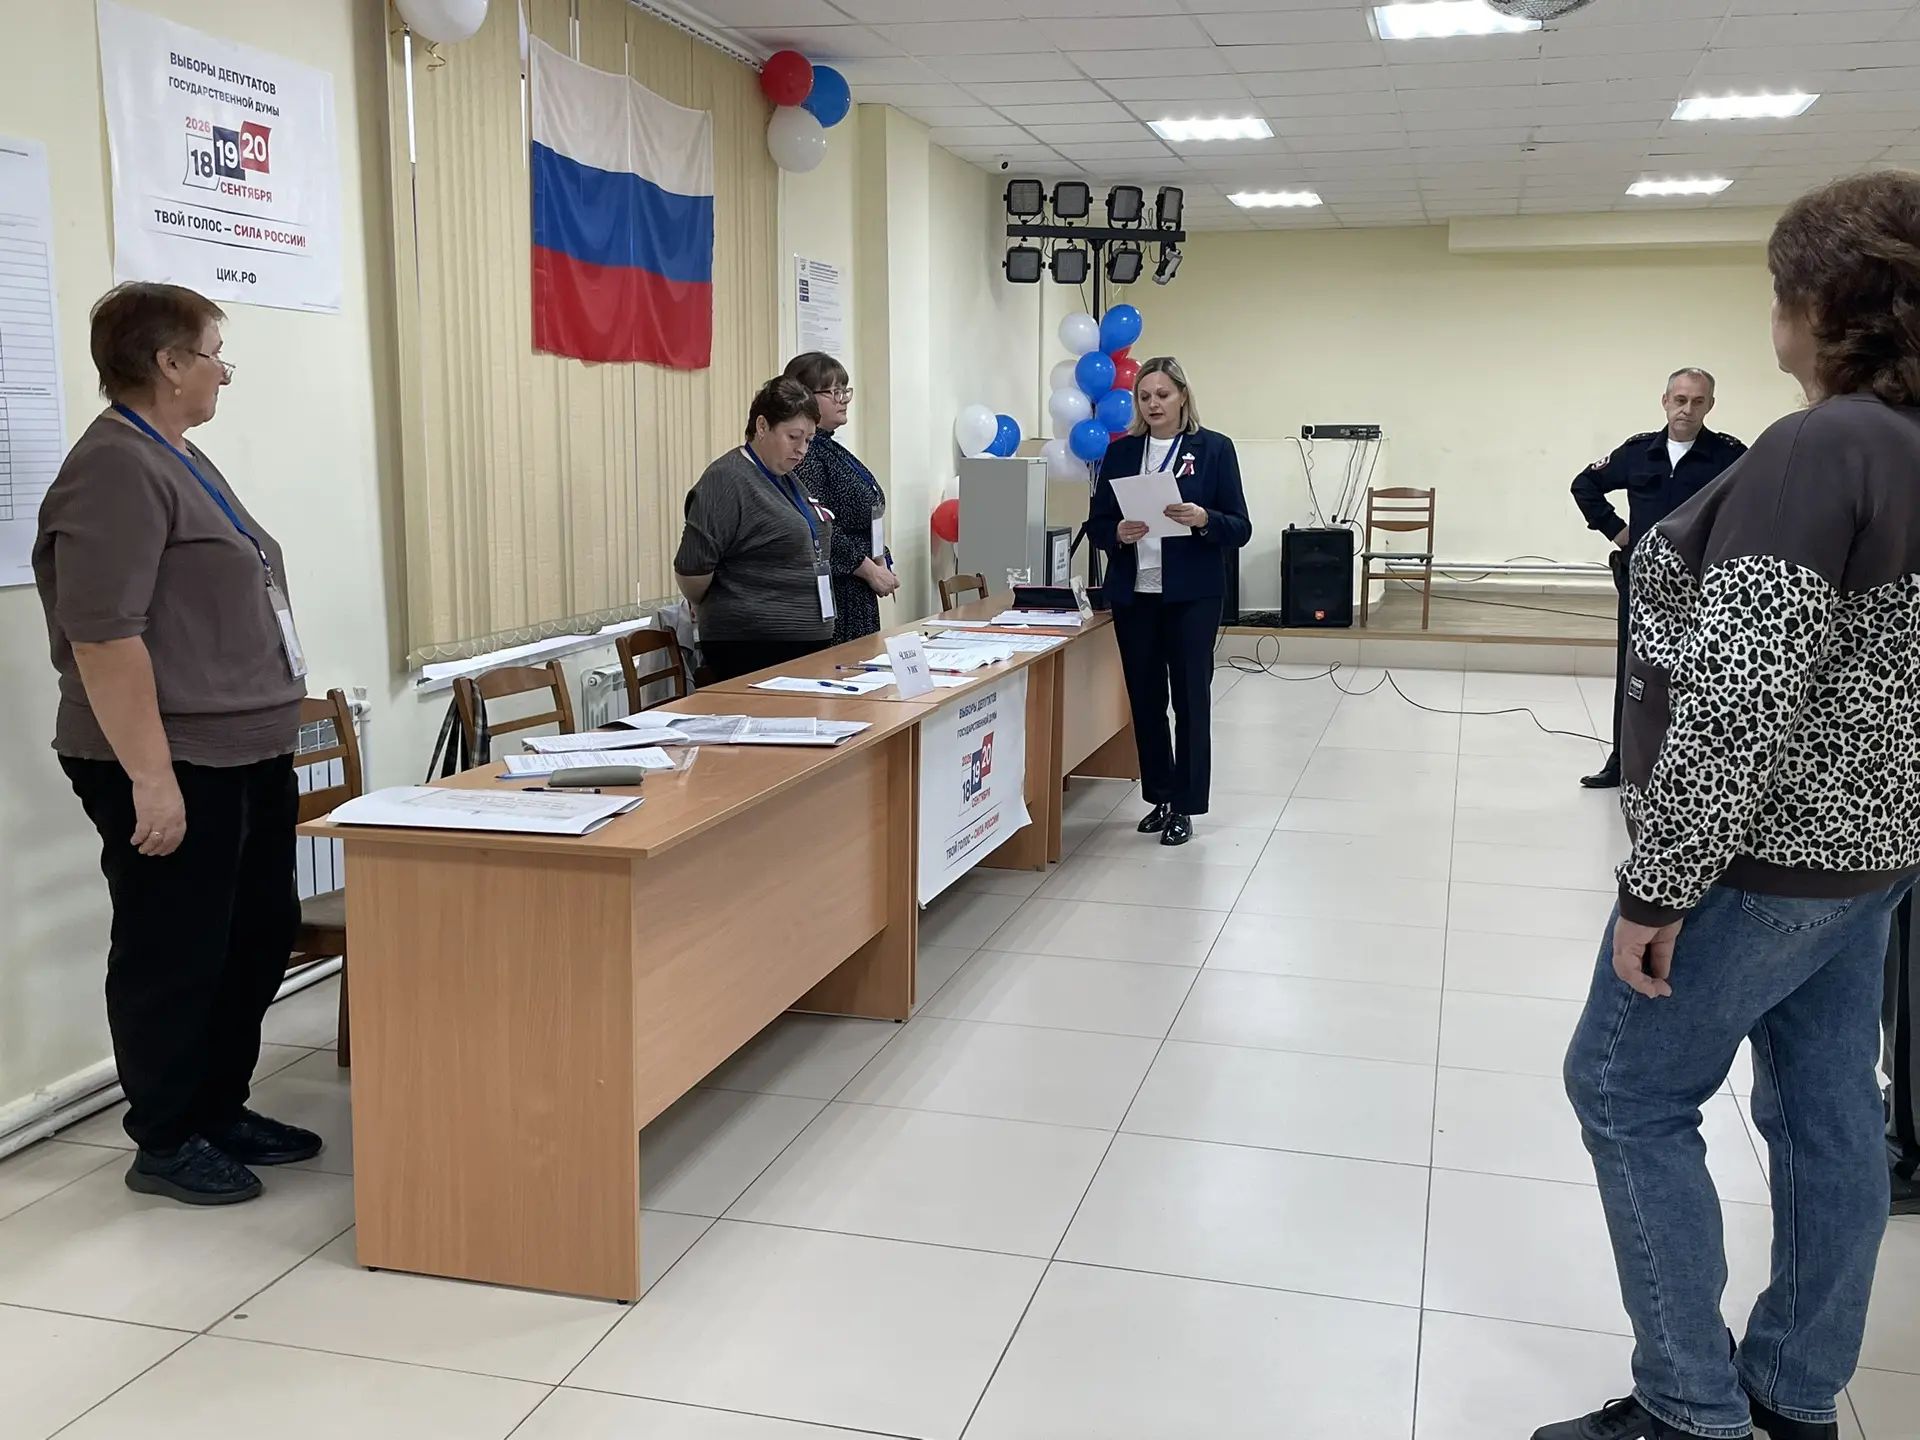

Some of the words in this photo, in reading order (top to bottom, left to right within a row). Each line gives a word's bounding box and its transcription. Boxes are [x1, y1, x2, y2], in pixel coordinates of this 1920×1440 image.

[169, 52, 216, 77] ВЫБОРЫ
[218, 68, 276, 95] ДЕПУТАТОВ
[168, 76, 254, 110] ГОСУДАРСТВЕННОЙ
[255, 98, 280, 117] ДУМЫ
[185, 116, 211, 133] 2026
[190, 149, 213, 179] 18
[216, 138, 238, 169] 19
[241, 132, 267, 163] 20
[220, 182, 273, 203] СЕНТЯБРЯ
[154, 209, 186, 227] ТВОЙ
[187, 215, 222, 233] ГОЛОС
[233, 224, 262, 240] СИЛА
[264, 230, 307, 248] РОССИИ!
[216, 267, 258, 285] ЦИК.РФ
[962, 778, 971, 804] 18
[972, 760, 981, 785] 19
[981, 743, 992, 769] 20
